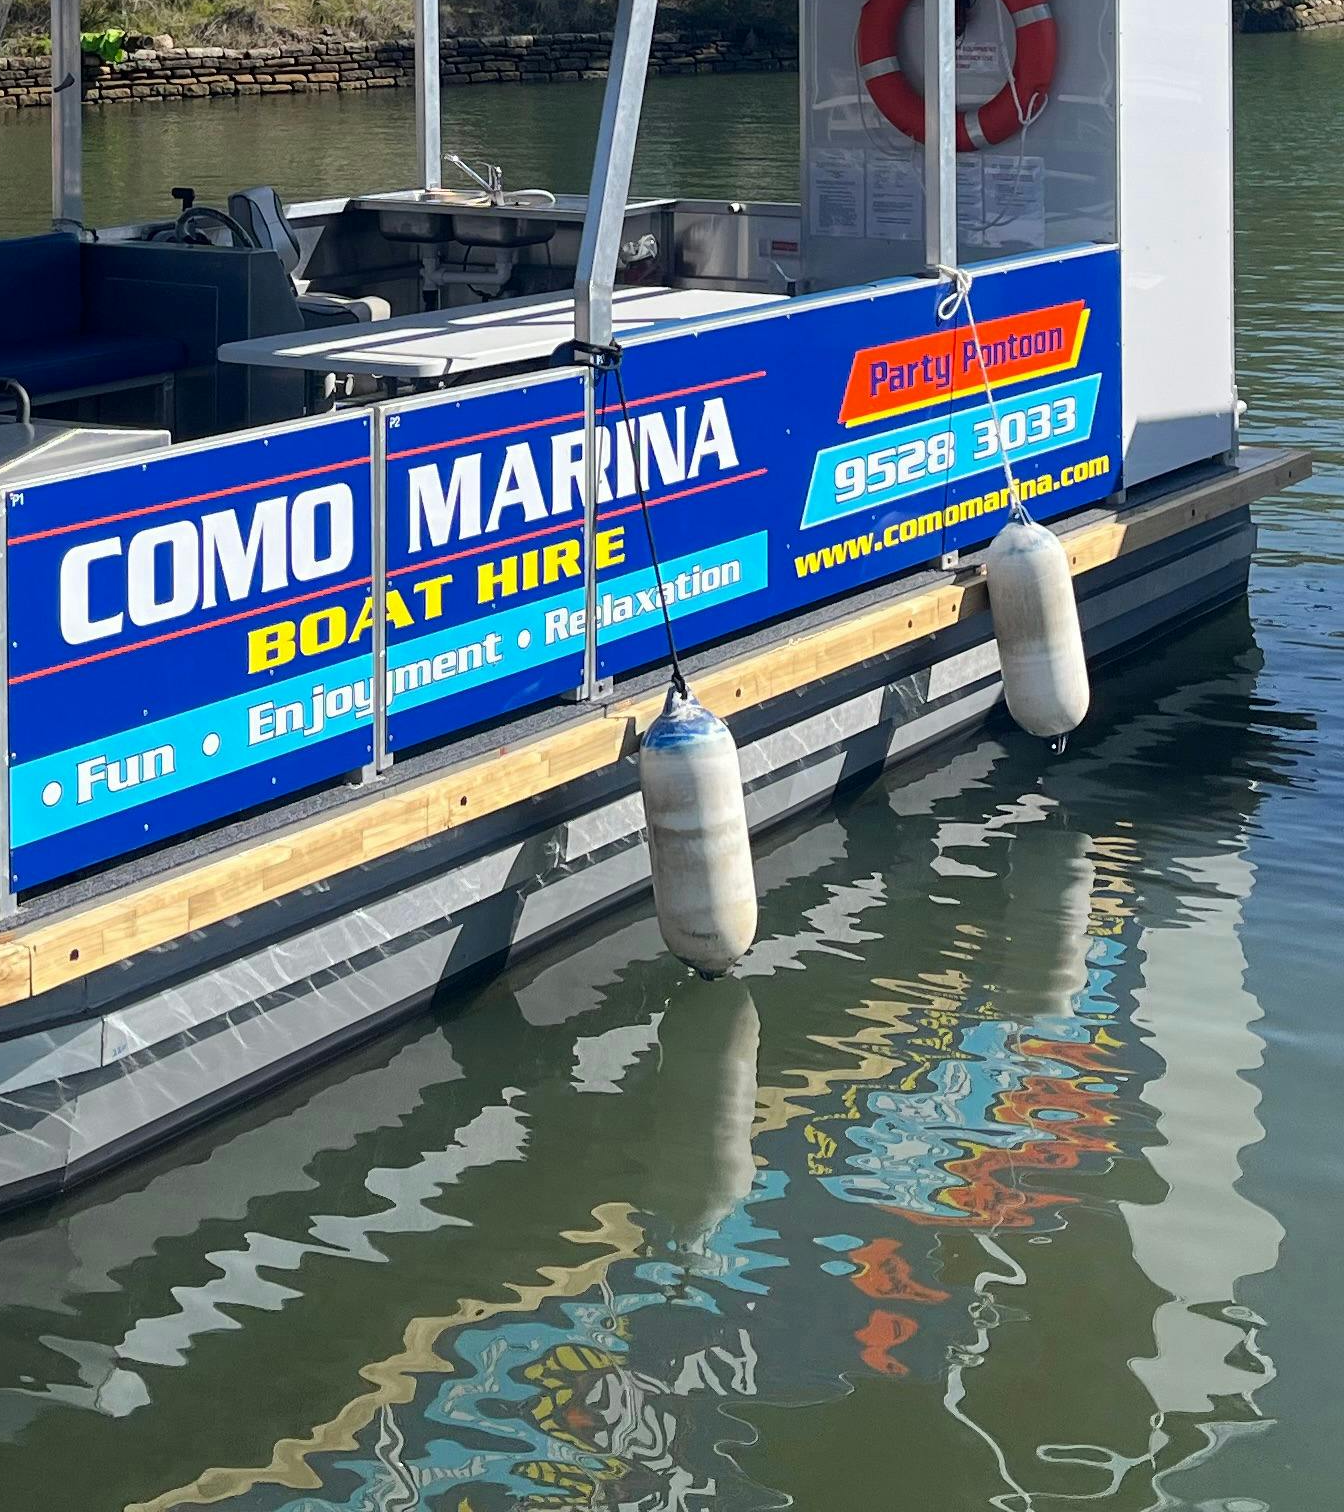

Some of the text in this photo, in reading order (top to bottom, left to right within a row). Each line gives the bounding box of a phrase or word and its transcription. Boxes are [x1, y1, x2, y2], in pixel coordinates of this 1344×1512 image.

[389, 415, 401, 429] P2
[869, 327, 1063, 398] Party Pontoon
[834, 396, 1077, 504] 9528 3033
[59, 397, 741, 646] COMO MARINA
[793, 454, 1111, 578] www.comomarina.com
[247, 526, 626, 676] BOAT HIRE
[76, 558, 741, 805] Fun Enjoyment Relaxation
